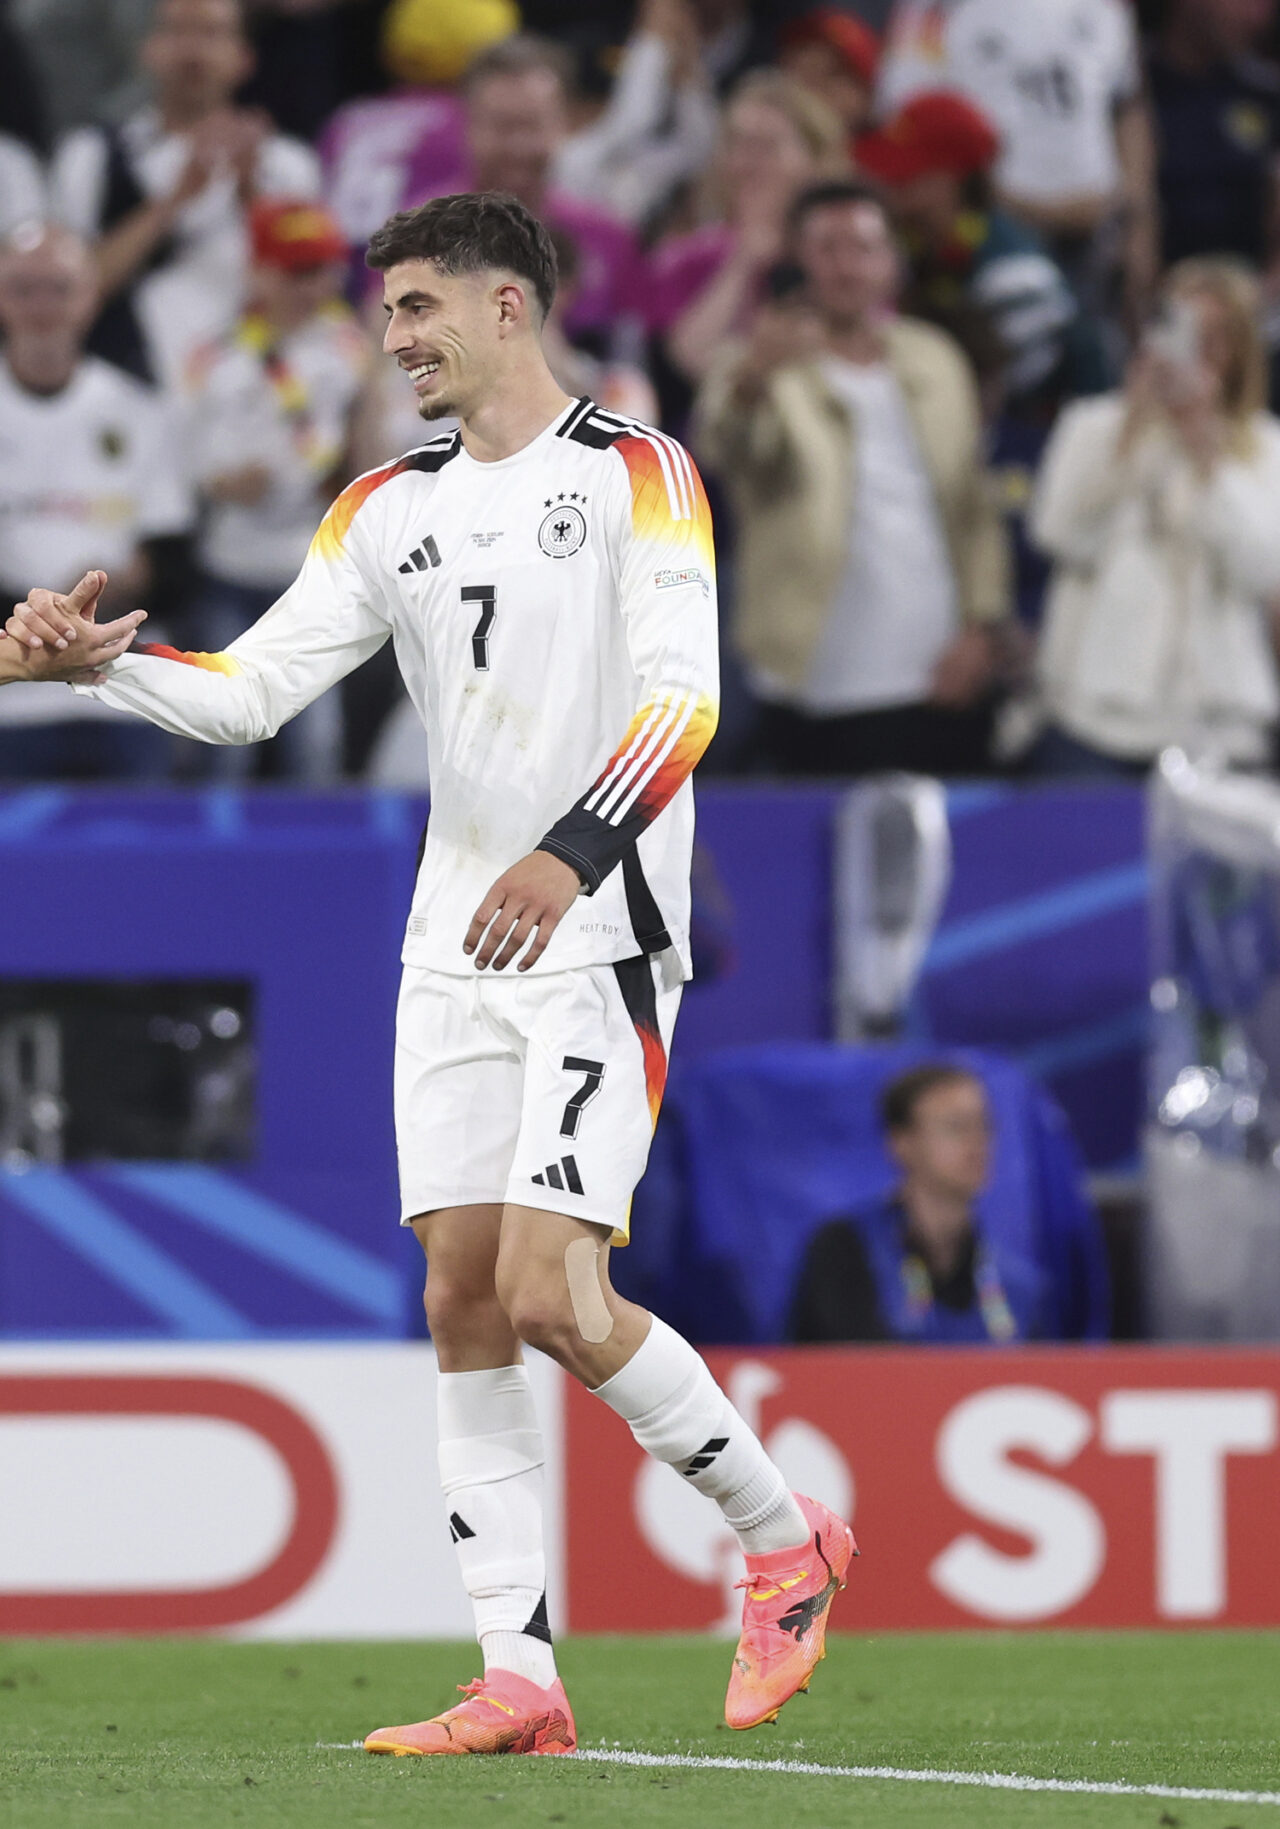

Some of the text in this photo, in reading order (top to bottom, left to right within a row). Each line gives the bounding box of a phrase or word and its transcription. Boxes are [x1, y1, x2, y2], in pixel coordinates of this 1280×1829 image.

[460, 584, 498, 672] 7
[559, 1055, 608, 1141] 7
[928, 1384, 1278, 1621] ST
